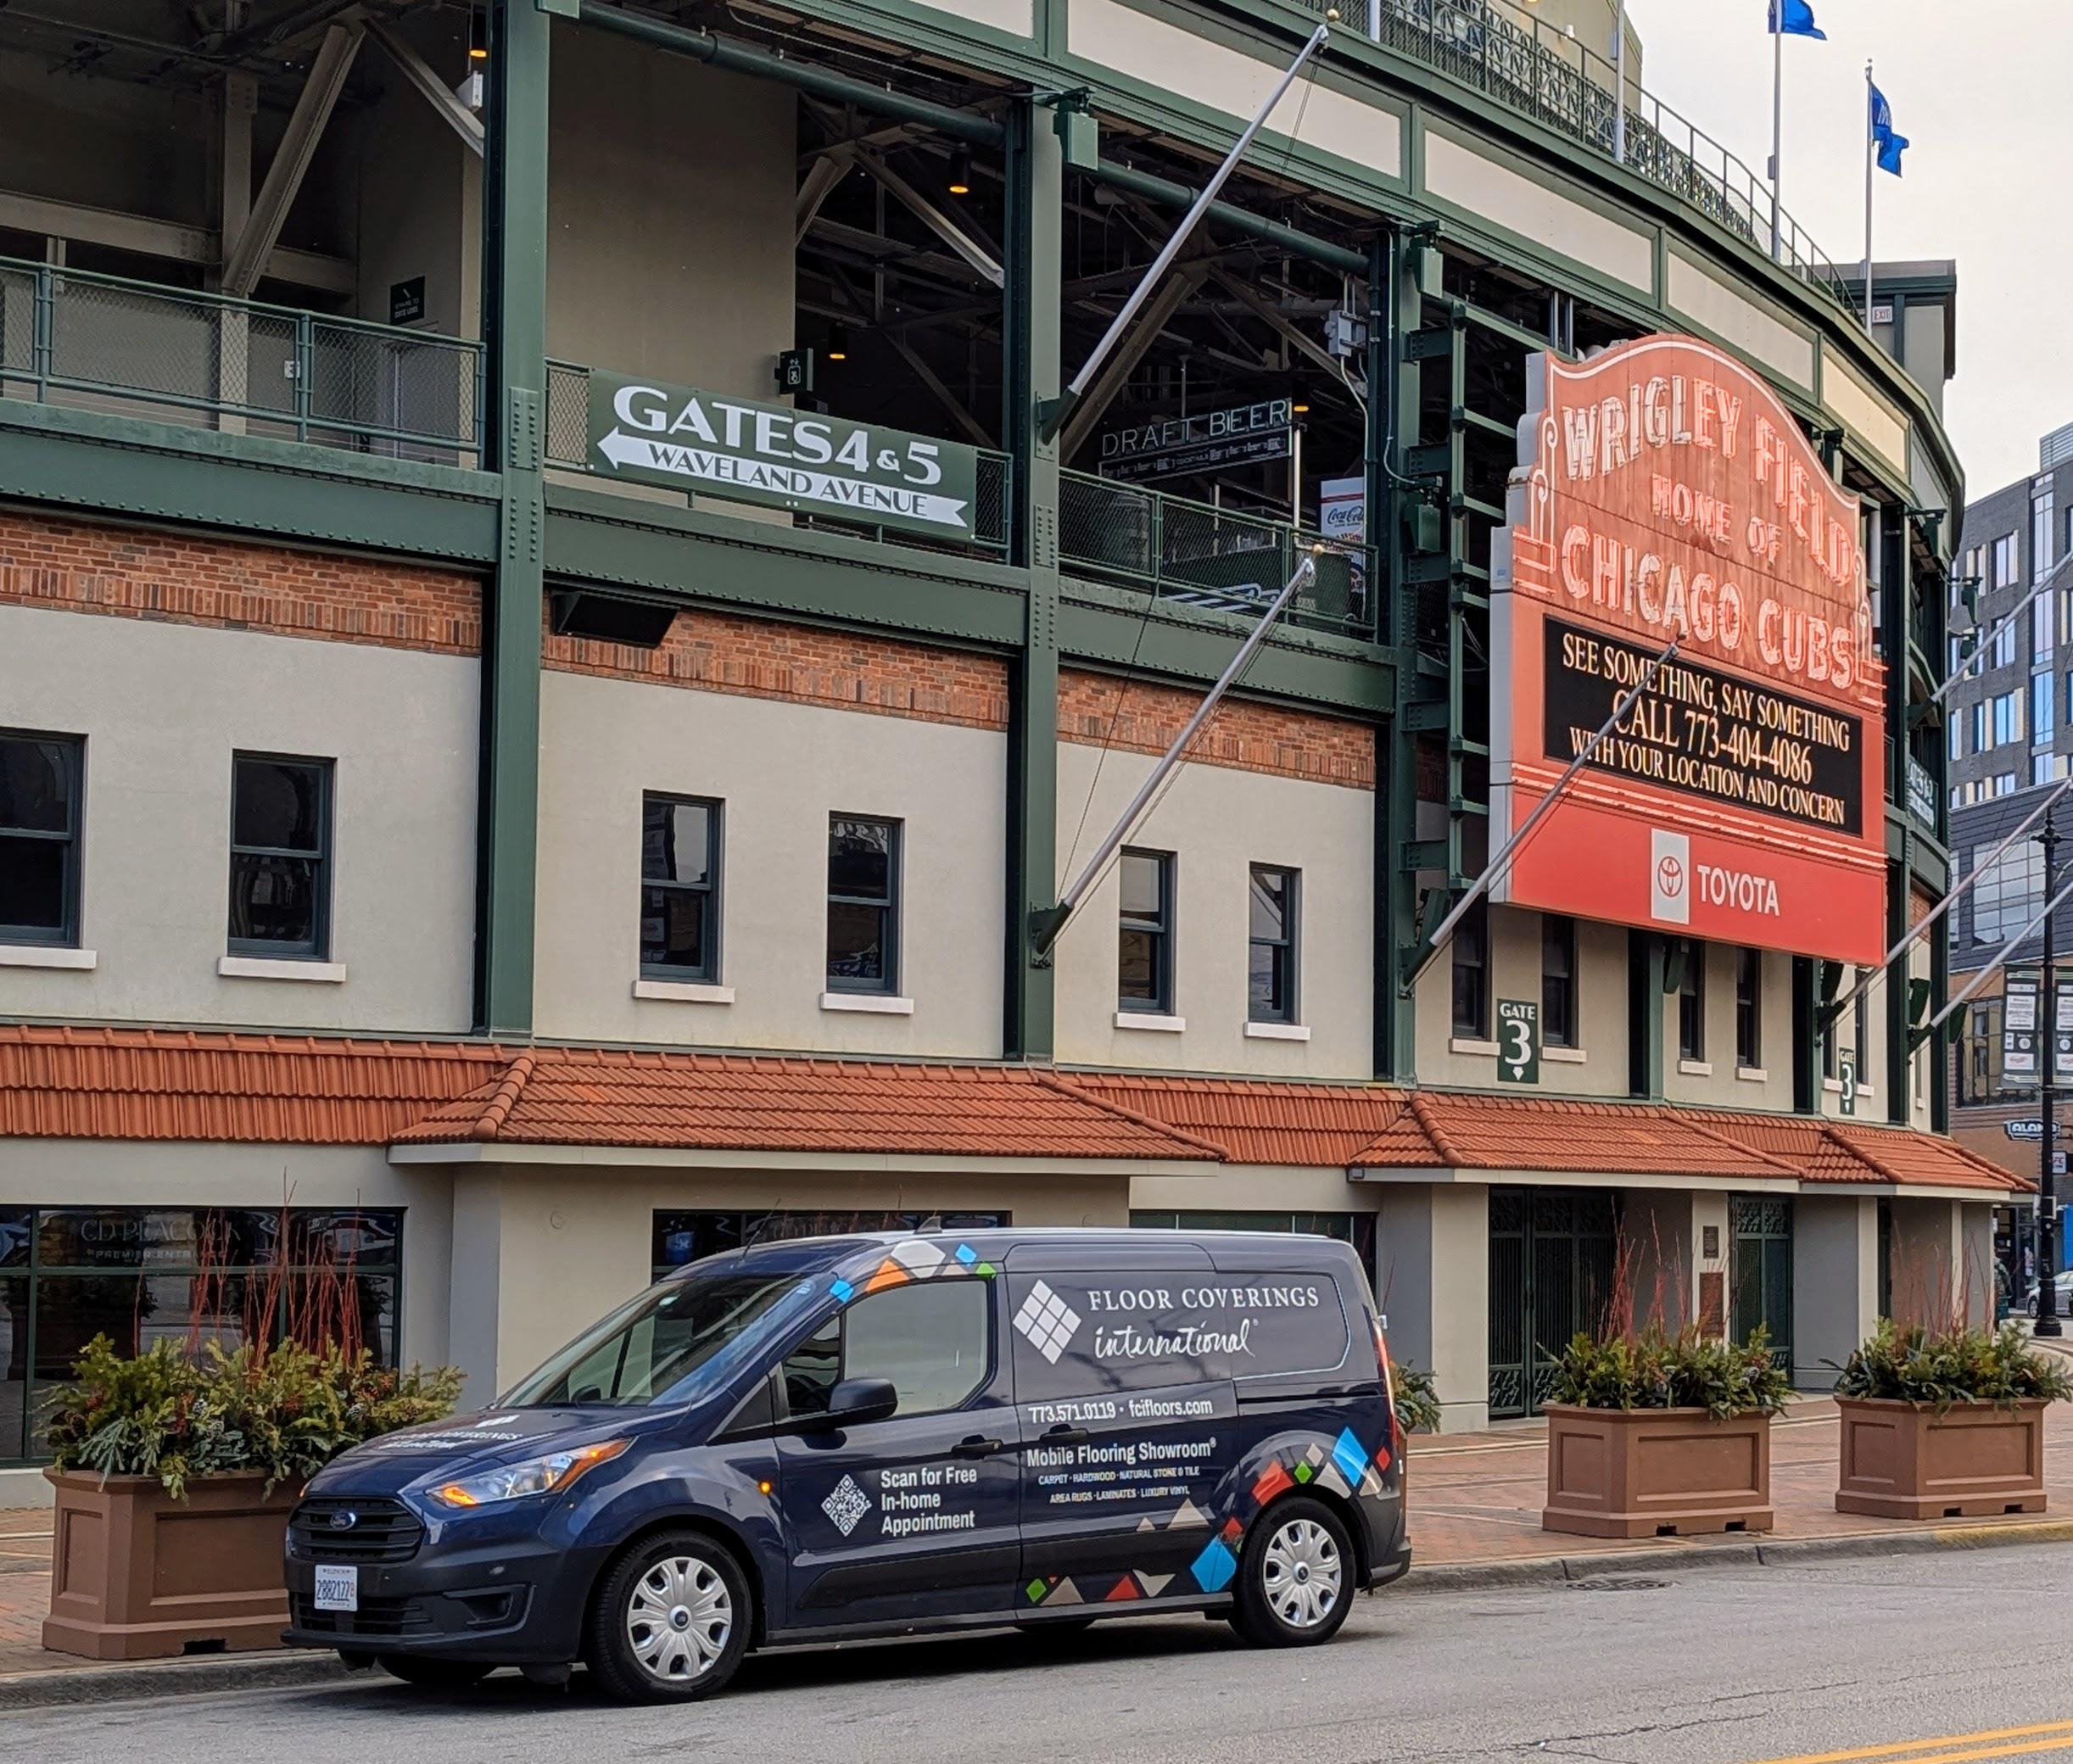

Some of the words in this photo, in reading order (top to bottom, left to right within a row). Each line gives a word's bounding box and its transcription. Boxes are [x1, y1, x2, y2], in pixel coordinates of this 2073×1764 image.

[613, 386, 833, 464] GATES
[835, 431, 869, 472] 4
[877, 449, 900, 472] &
[903, 440, 942, 484] 5
[1103, 417, 1195, 456] DRAFT
[1210, 399, 1286, 437] BEER
[649, 444, 812, 494] WAVELAND
[820, 483, 927, 517] AVENUE
[1562, 375, 1741, 480] WRIGLEY
[1754, 413, 1852, 587] FIELD
[1651, 473, 1732, 544] HOME
[1746, 516, 1783, 567] OF
[1562, 523, 1743, 650] CHICAGO
[1757, 599, 1855, 689] CUBS
[1563, 633, 1599, 675] SEE
[1604, 646, 1718, 717] SOMETHING,
[1722, 683, 1754, 721] SAY
[1757, 695, 1850, 751] SOMETHING
[1613, 689, 1679, 748] CALL
[1685, 710, 1812, 784] 773-404-4086
[1570, 727, 1614, 766] WITH
[1618, 740, 1664, 779] YOUR
[1668, 753, 1744, 798] LOCATION
[1746, 776, 1778, 807] AND
[1780, 784, 1845, 825] CONCERN
[1697, 865, 1780, 917] TOYOTA
[1500, 1003, 1535, 1020] GATE
[1505, 1019, 1531, 1065] 3
[1840, 1051, 1854, 1063] GATE
[1841, 1064, 1852, 1100] 3
[1087, 1288, 1174, 1310] FLOOR
[1182, 1287, 1319, 1309] COVERINGS
[1028, 1401, 1116, 1423] 773.571.0119
[1128, 1399, 1213, 1417] fcifloors.com
[1026, 1447, 1074, 1467] Mobile
[1078, 1443, 1136, 1465] Flooring
[1038, 1474, 1068, 1485] CARPET
[1072, 1471, 1116, 1482] HARDWOOD
[1119, 1469, 1152, 1480] NATURAL
[1154, 1467, 1177, 1478] STONE
[1184, 1466, 1199, 1477] TILE
[881, 1470, 917, 1488] Scan
[921, 1467, 942, 1485] for
[946, 1466, 977, 1484] Free
[1050, 1493, 1070, 1504] AREA
[1071, 1492, 1092, 1502] RUGS
[1096, 1489, 1136, 1500] LAMINATES
[1141, 1487, 1168, 1497] LUXURY
[1170, 1486, 1190, 1495] VINYL
[881, 1491, 941, 1510] In-home
[881, 1510, 975, 1537] Appointment
